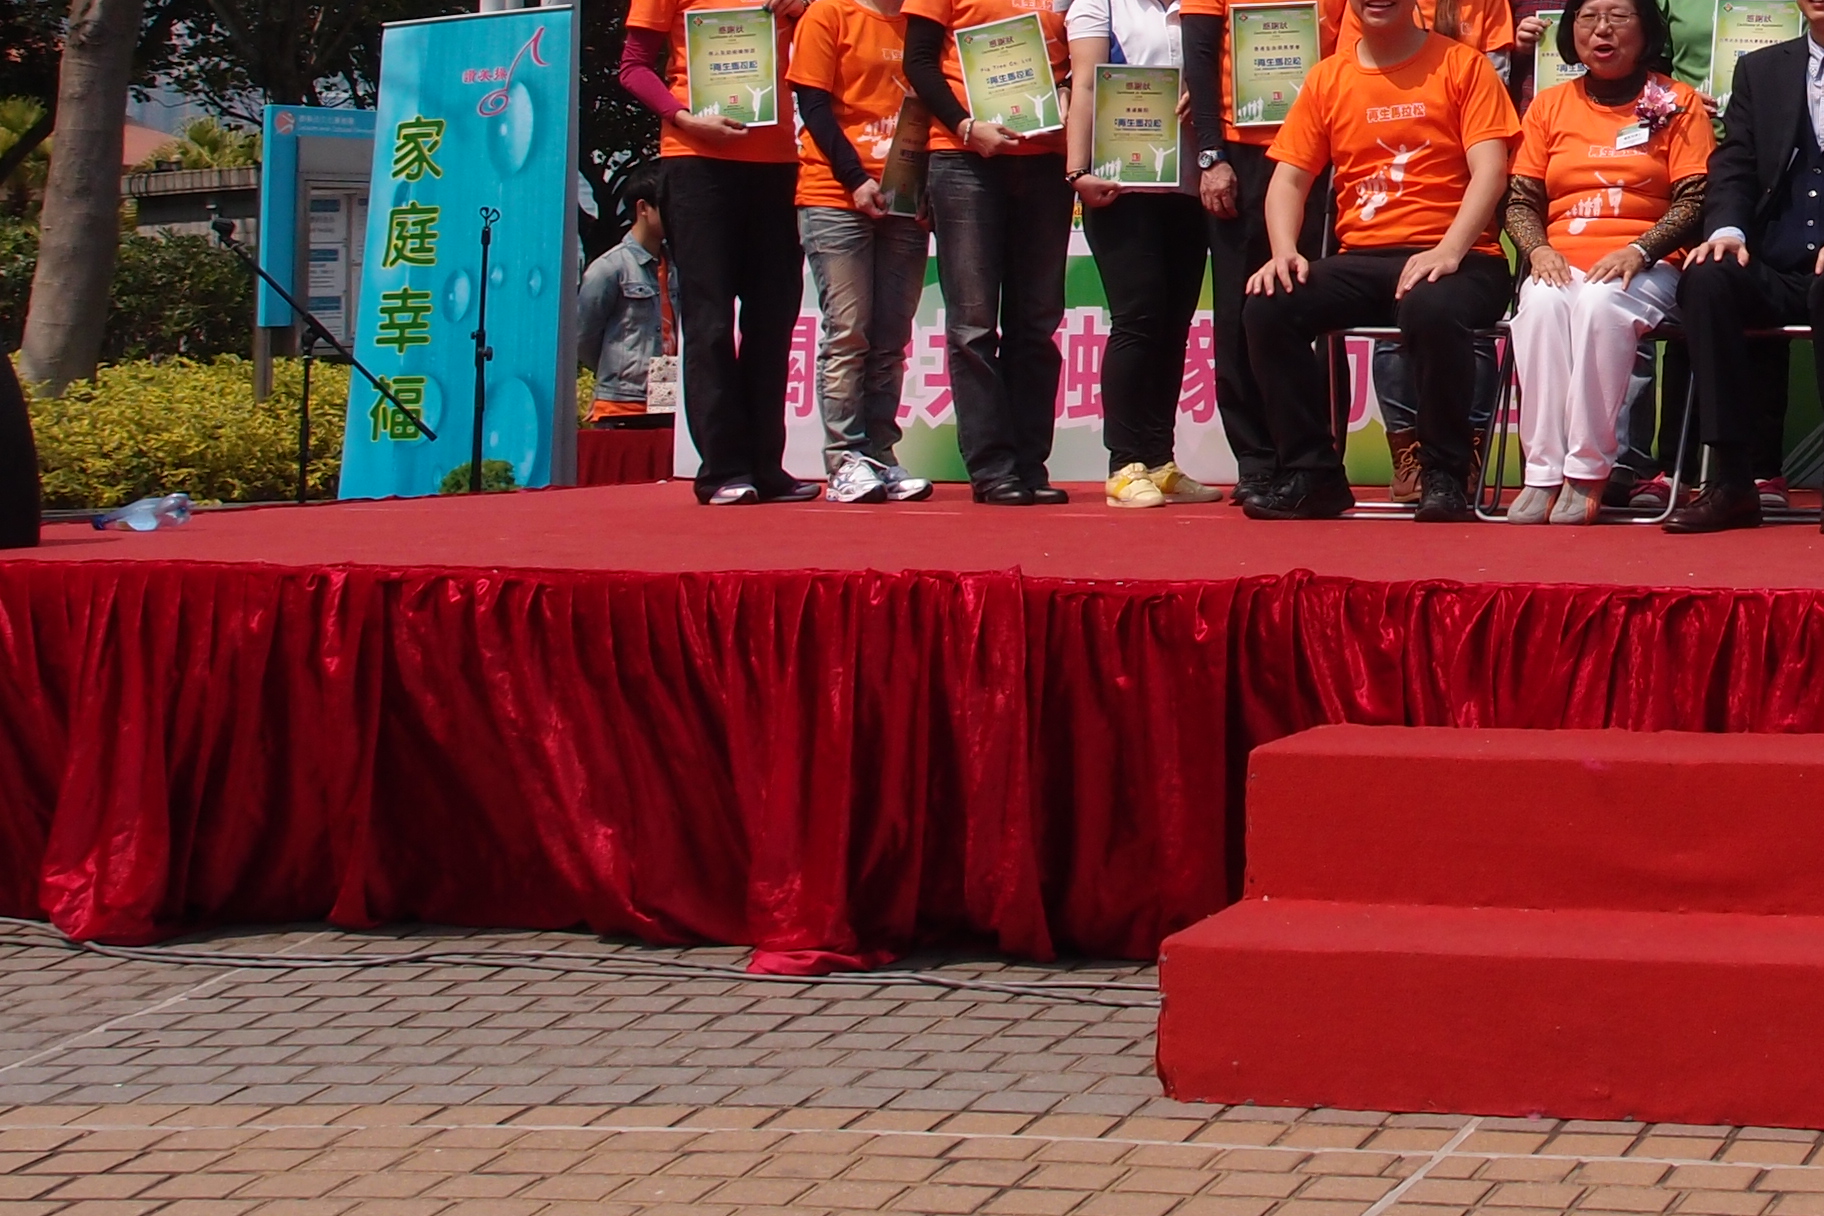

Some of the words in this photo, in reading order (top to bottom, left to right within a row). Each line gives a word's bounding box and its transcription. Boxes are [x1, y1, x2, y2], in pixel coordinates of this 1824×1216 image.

[1366, 103, 1425, 123] 再生馬拉松
[370, 116, 446, 443] 家庭幸福
